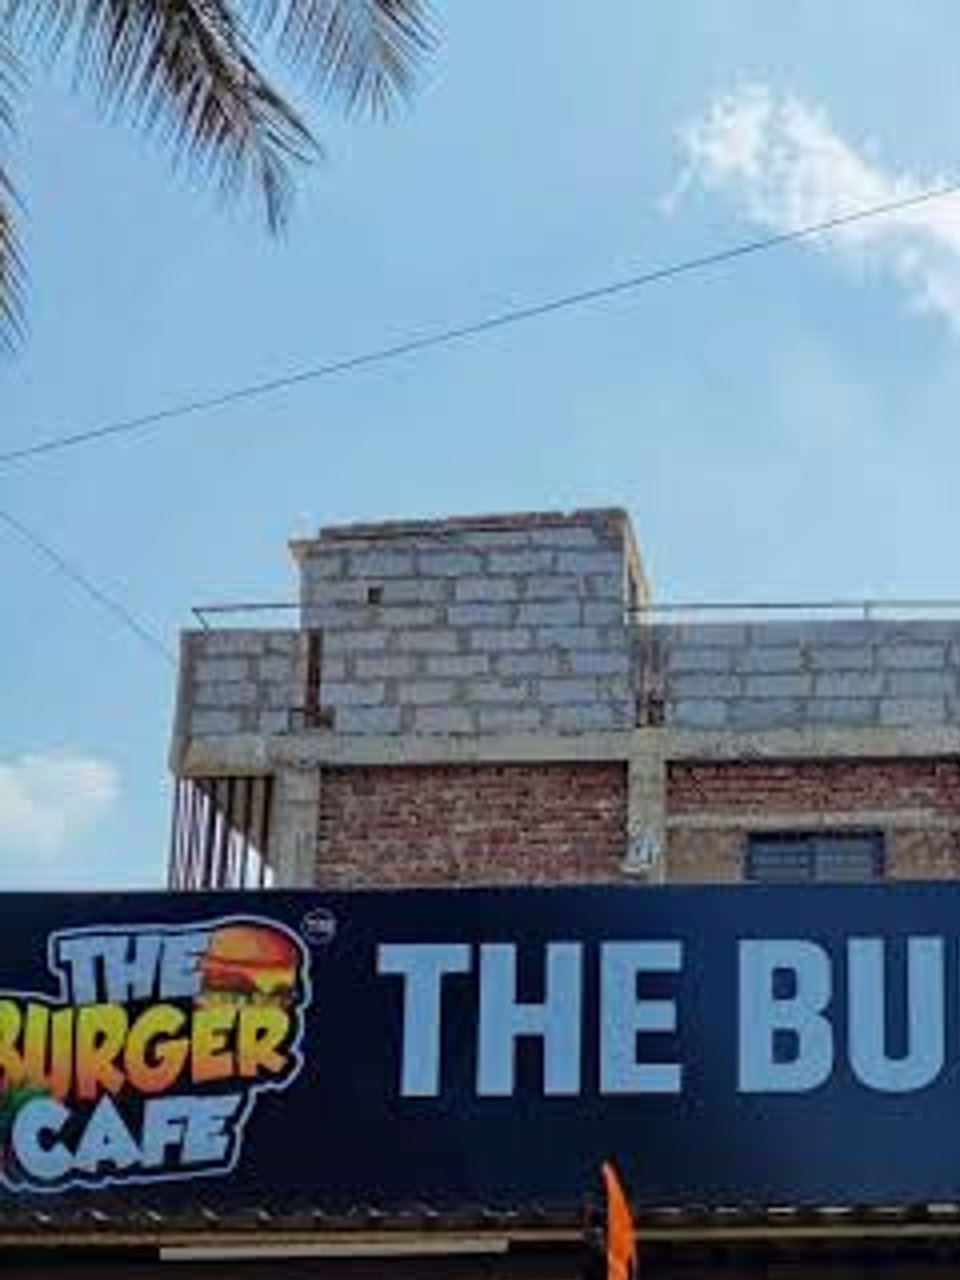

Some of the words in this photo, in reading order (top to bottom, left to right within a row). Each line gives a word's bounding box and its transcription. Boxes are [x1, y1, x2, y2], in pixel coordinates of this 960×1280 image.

[59, 934, 208, 1004] THE
[377, 941, 683, 1096] THE
[11, 1093, 242, 1180] CAFE
